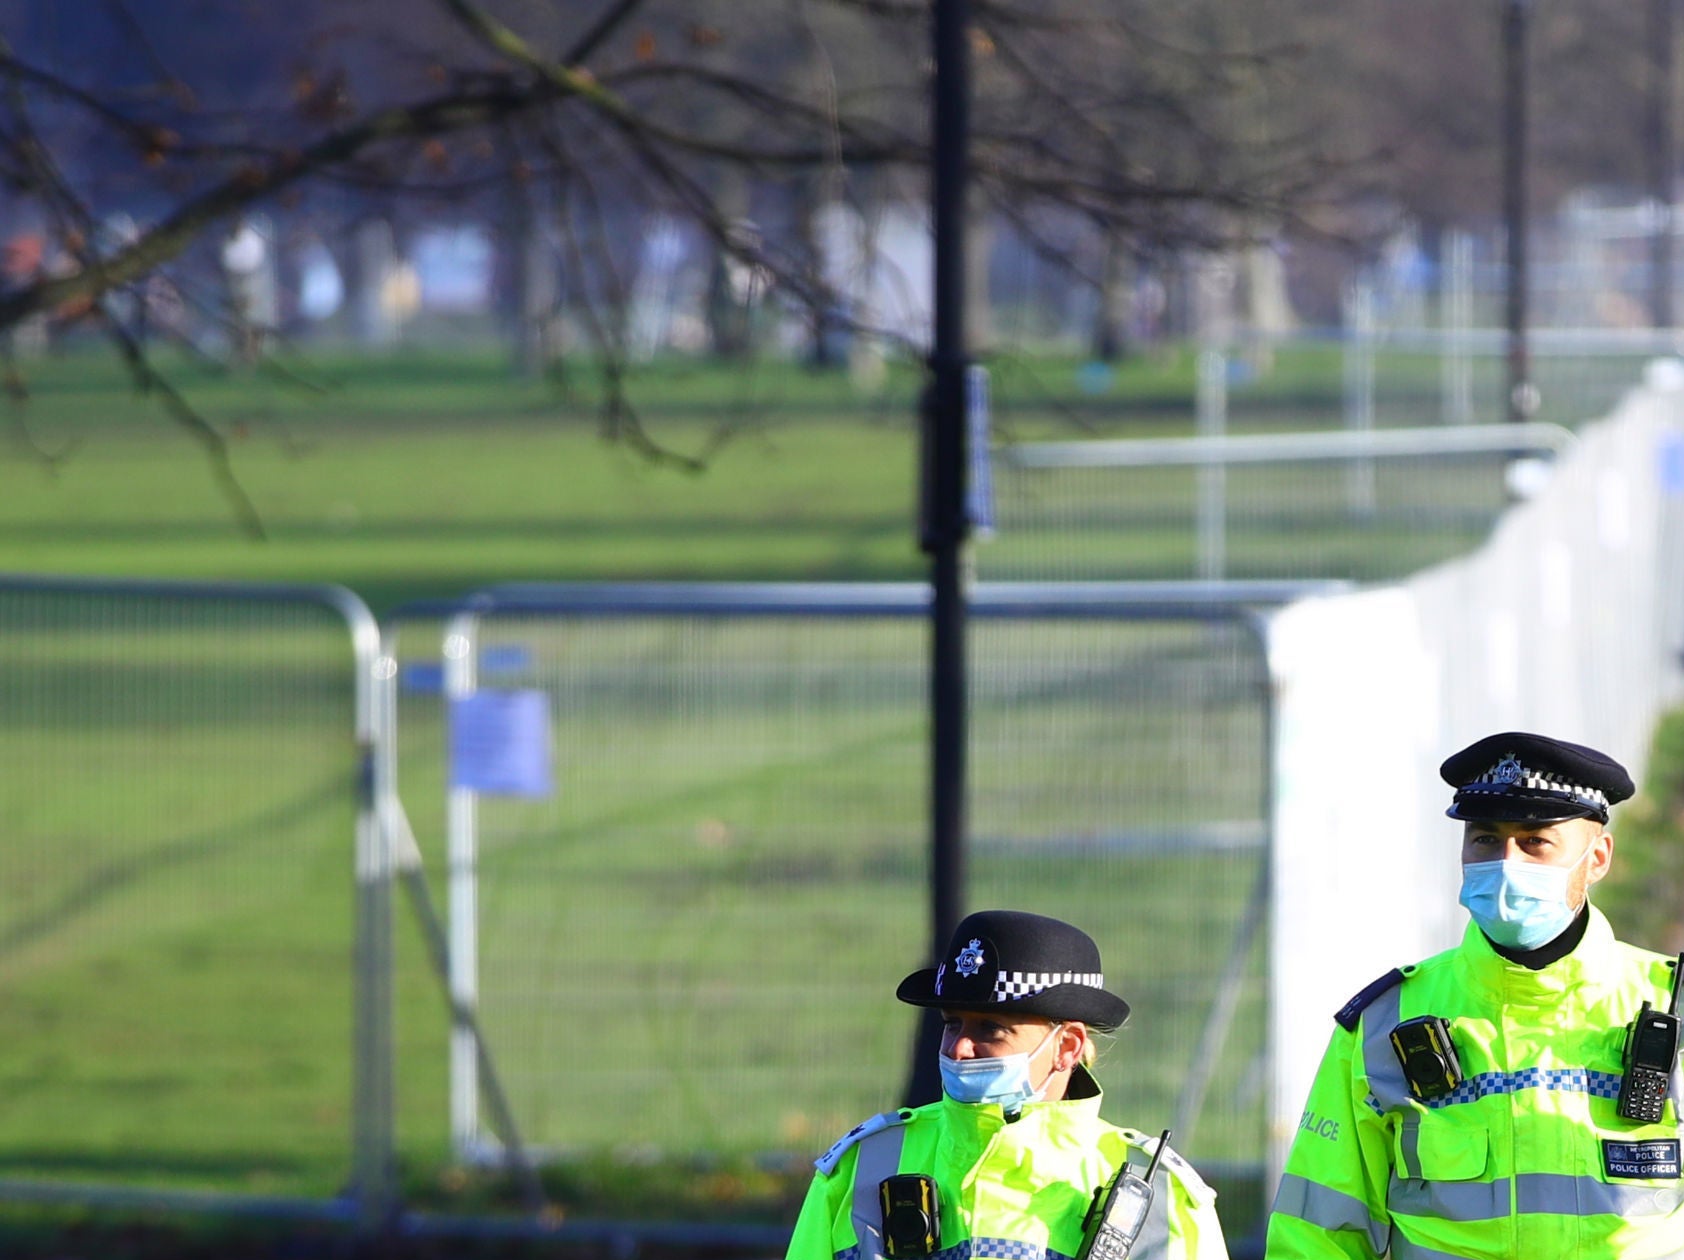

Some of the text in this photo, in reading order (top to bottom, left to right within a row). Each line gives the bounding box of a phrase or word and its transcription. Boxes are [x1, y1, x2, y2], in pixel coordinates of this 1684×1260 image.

[1635, 1151, 1665, 1160] POLICE
[1610, 1163, 1677, 1173] POLICE OFFICER
